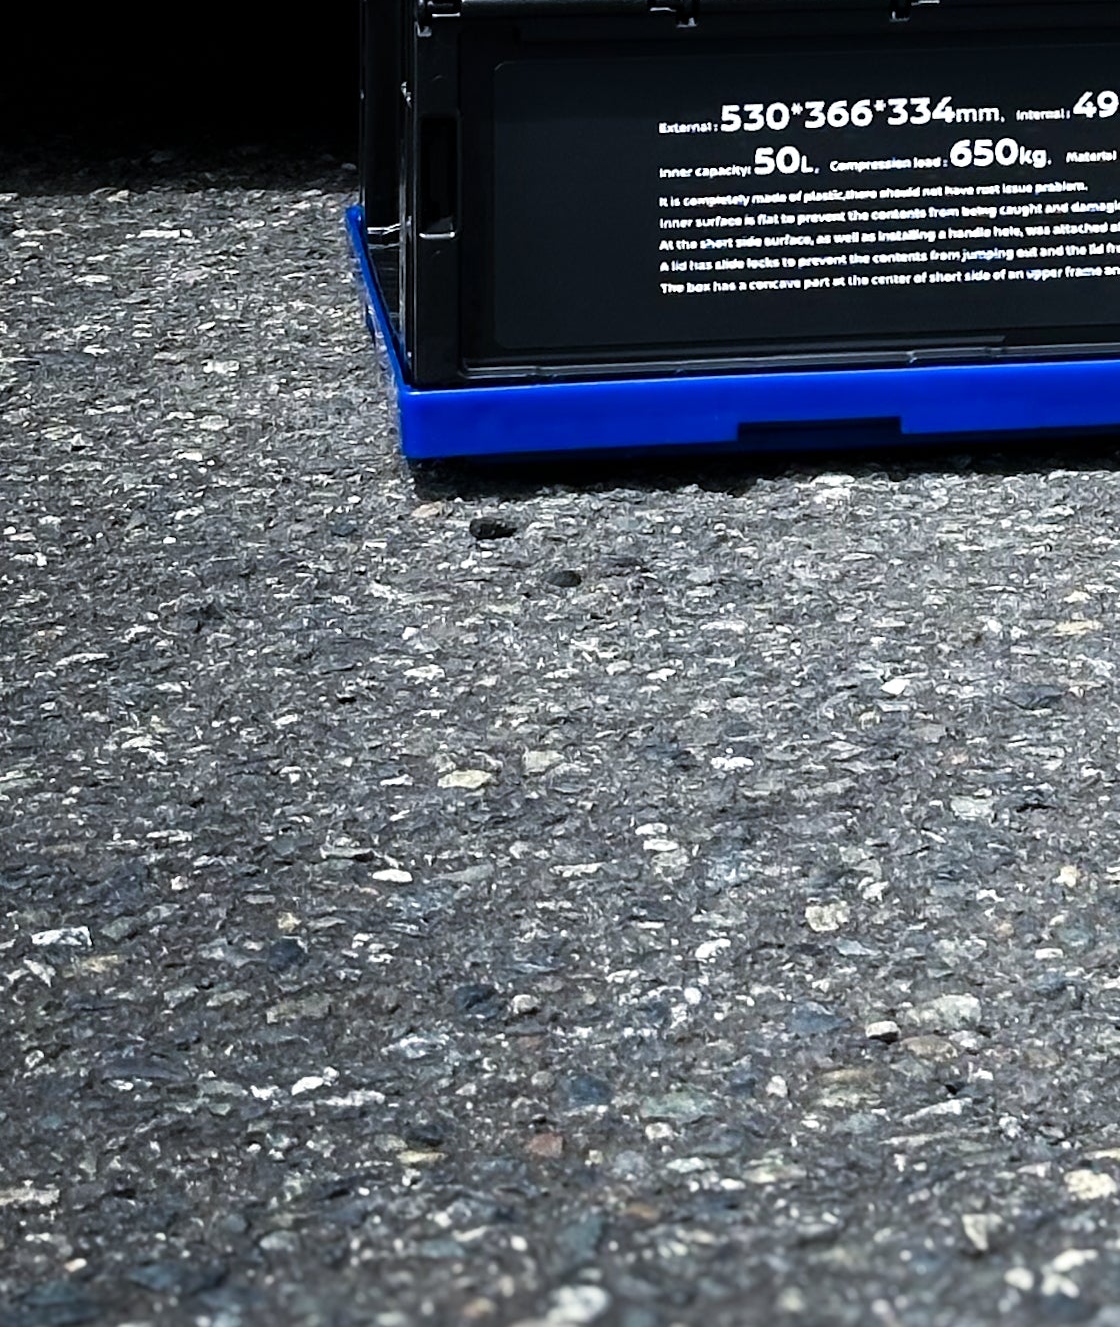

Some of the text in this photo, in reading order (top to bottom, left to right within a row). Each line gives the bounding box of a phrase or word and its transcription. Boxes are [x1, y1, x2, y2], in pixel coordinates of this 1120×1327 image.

[660, 168, 693, 178] Inner
[830, 158, 911, 172] Compression
[659, 197, 668, 207] It
[670, 195, 680, 206] is
[682, 194, 750, 207] completely
[751, 192, 786, 203] made
[788, 190, 802, 202] of
[879, 186, 920, 198] should
[922, 185, 942, 196] not
[944, 185, 974, 195] have
[659, 218, 692, 228] Inner
[695, 215, 742, 227] surface
[744, 214, 755, 226] is
[757, 213, 779, 225] flat
[780, 213, 795, 224] to
[797, 211, 845, 225] prevent
[847, 209, 868, 221] the
[870, 207, 926, 220] contents
[928, 206, 959, 217] from
[961, 205, 997, 218] being
[999, 203, 1042, 217] caught
[1044, 202, 1068, 213] and
[659, 239, 674, 250] At
[676, 239, 697, 250] the
[700, 237, 733, 249] short
[735, 235, 762, 248] side
[816, 234, 830, 244] as
[833, 231, 859, 243] well
[861, 232, 876, 242] as
[878, 228, 936, 242] installing
[938, 229, 946, 239] a
[948, 226, 991, 239] handle
[1024, 225, 1050, 236] was
[1052, 221, 1108, 235] attached
[671, 260, 686, 271] lid
[689, 259, 712, 271] has
[715, 258, 744, 270] slide
[746, 256, 780, 269] locks
[781, 257, 796, 267] to
[798, 254, 846, 268] prevent
[849, 253, 870, 264] the
[872, 251, 928, 263] contents
[930, 249, 960, 260] from
[961, 247, 1014, 262] jumping
[1039, 244, 1064, 257] and
[1065, 244, 1086, 256] the
[1088, 242, 1104, 255] lid
[660, 282, 684, 293] The
[686, 282, 710, 293] box
[713, 280, 736, 292] has
[738, 281, 746, 290] a
[748, 279, 800, 290] concave
[804, 276, 829, 290] part
[832, 276, 845, 286] at
[848, 274, 868, 286] the
[871, 274, 911, 285] center
[913, 271, 926, 283] of
[929, 271, 962, 283] short
[964, 269, 990, 281] side
[992, 268, 1006, 280] of
[1008, 269, 1024, 279] an
[1026, 268, 1062, 281] upper
[1065, 265, 1102, 277] frame
